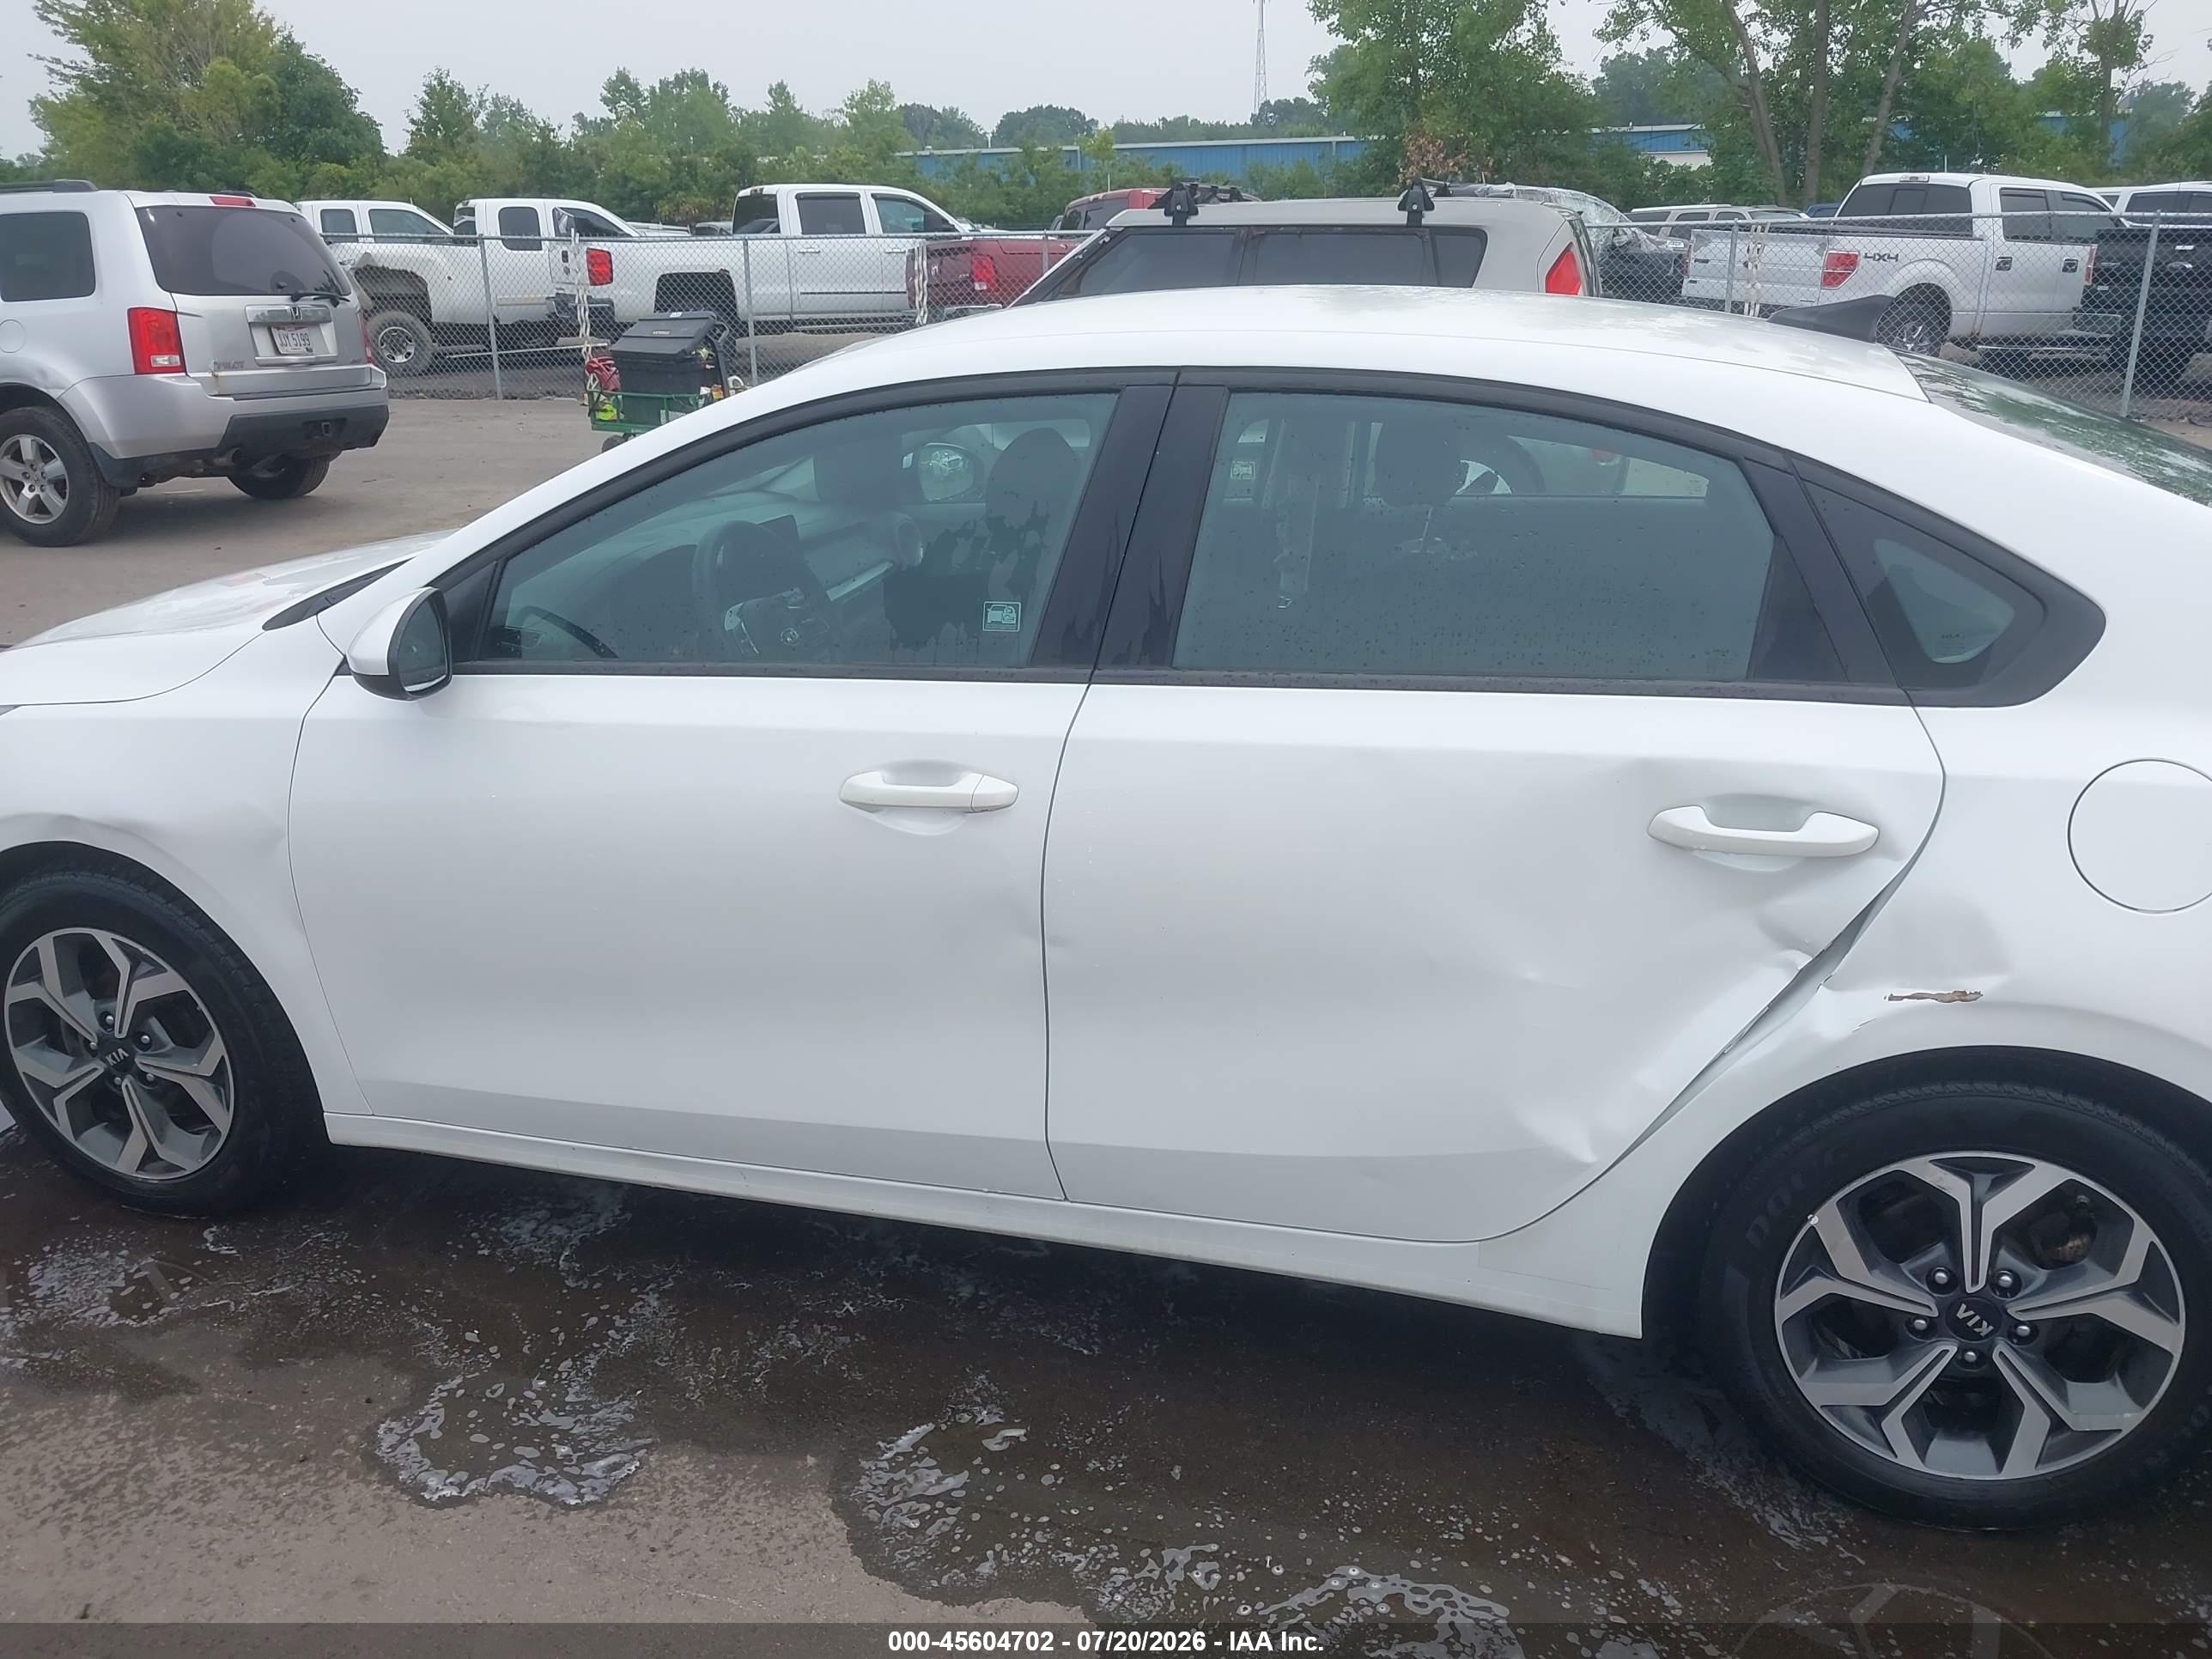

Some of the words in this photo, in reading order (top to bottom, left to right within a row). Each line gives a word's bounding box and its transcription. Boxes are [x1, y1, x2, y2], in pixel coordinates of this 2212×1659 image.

[291, 332, 311, 347] 5199
[105, 1048, 130, 1066] KIA
[1956, 1303, 1995, 1337] KIA
